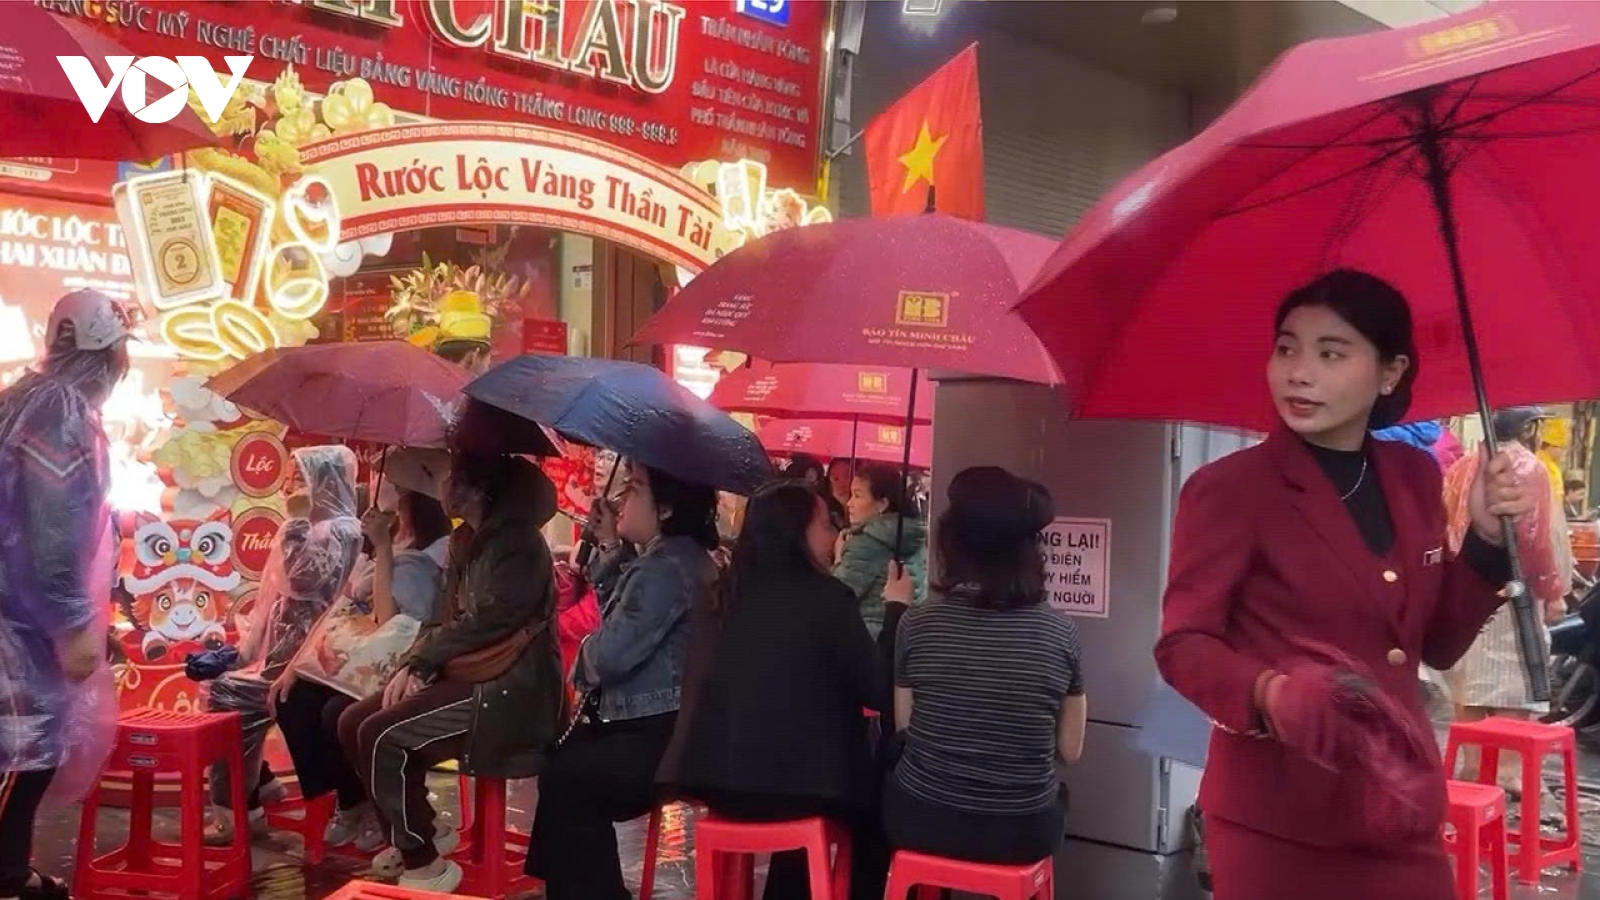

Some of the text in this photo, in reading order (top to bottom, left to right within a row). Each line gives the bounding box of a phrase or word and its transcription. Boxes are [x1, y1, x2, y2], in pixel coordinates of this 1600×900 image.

[156, 10, 191, 39] MỸ
[315, 46, 356, 77] LIỆU
[415, 66, 461, 98] VÀNG
[512, 91, 565, 121] THĂNG
[567, 105, 606, 130] LONG
[355, 153, 714, 252] Rước Lộc Vàng Thần Tài
[52, 214, 101, 246] LỘC
[39, 245, 107, 274] XUÂN
[174, 253, 187, 271] 2
[245, 453, 275, 475] Lộc
[1067, 531, 1100, 552] LẠI!
[1053, 590, 1095, 606] NGƯỜI
